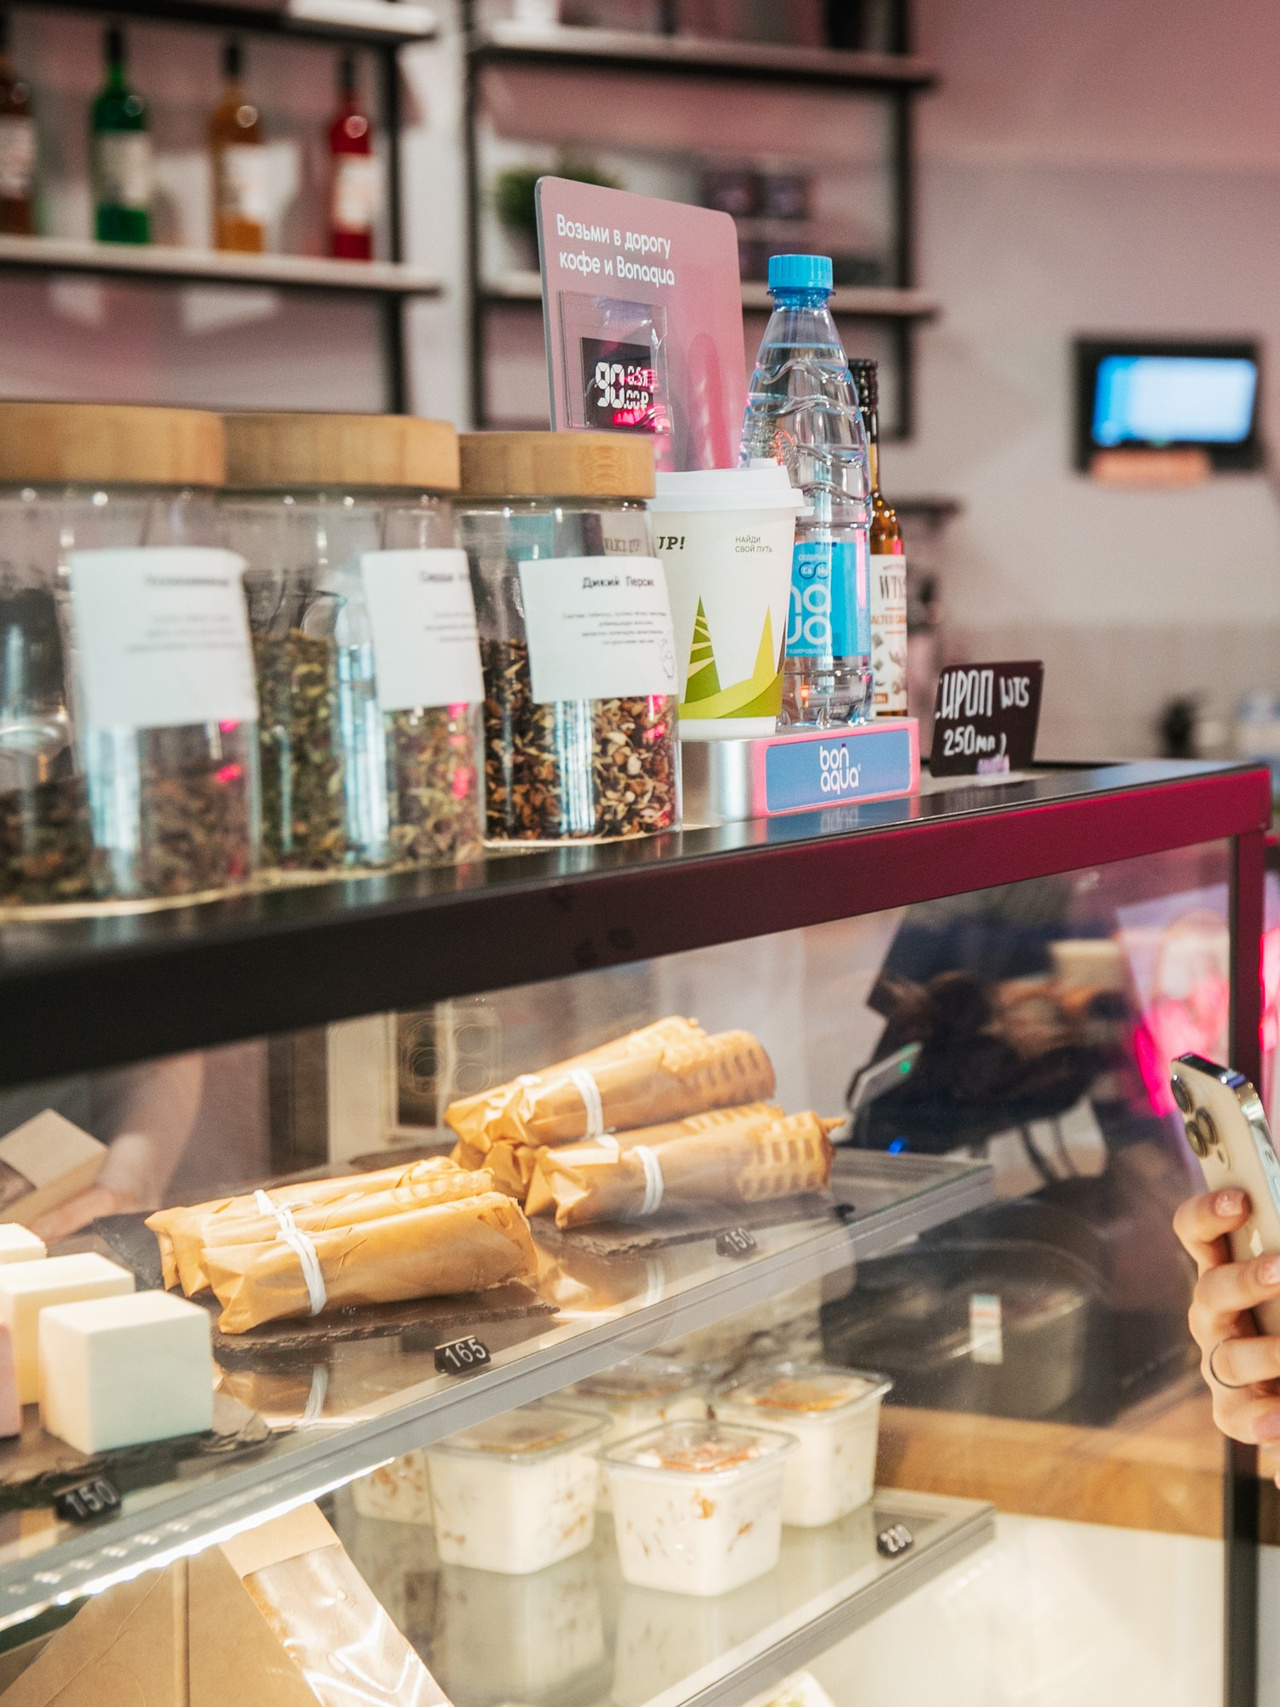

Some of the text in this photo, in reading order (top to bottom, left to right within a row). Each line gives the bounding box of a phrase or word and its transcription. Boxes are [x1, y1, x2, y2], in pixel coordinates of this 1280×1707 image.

[556, 213, 671, 259] Возьми в дорогу
[559, 250, 675, 288] кофе и Bonaqua
[735, 535, 761, 544] НАЙДИ
[735, 545, 755, 553] СВОЙ
[819, 744, 850, 771] bon
[820, 766, 859, 795] aqua
[724, 1228, 754, 1251] 150
[445, 1338, 487, 1367] 165
